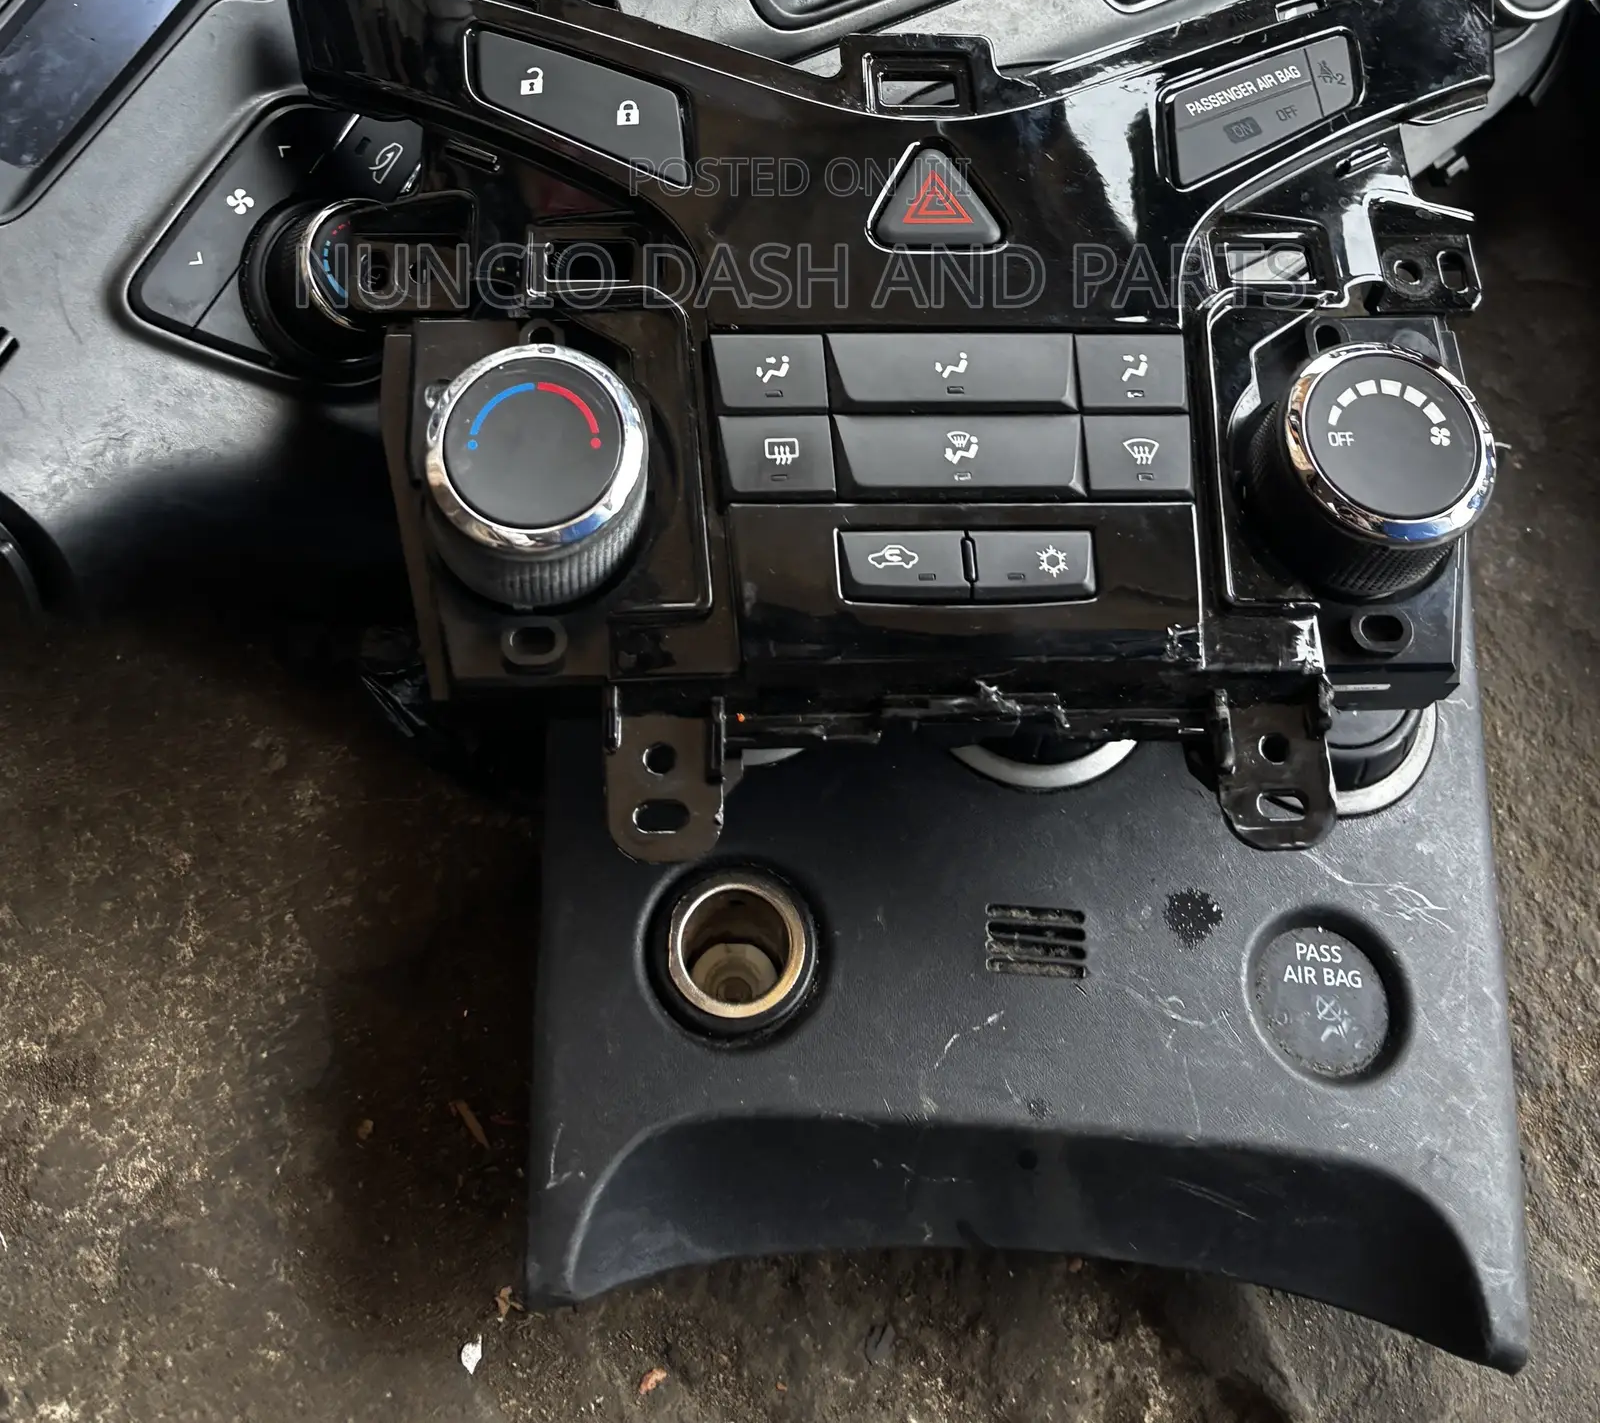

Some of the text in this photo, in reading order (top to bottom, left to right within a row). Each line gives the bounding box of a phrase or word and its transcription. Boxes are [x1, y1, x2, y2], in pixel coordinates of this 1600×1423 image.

[1186, 65, 1301, 116] PASSENGER AIR BAG
[1276, 104, 1298, 122] OFF
[1233, 125, 1254, 138] ON
[1327, 431, 1355, 447] OFF
[1295, 942, 1343, 964] PASS
[1283, 964, 1363, 989] AIR BAG
